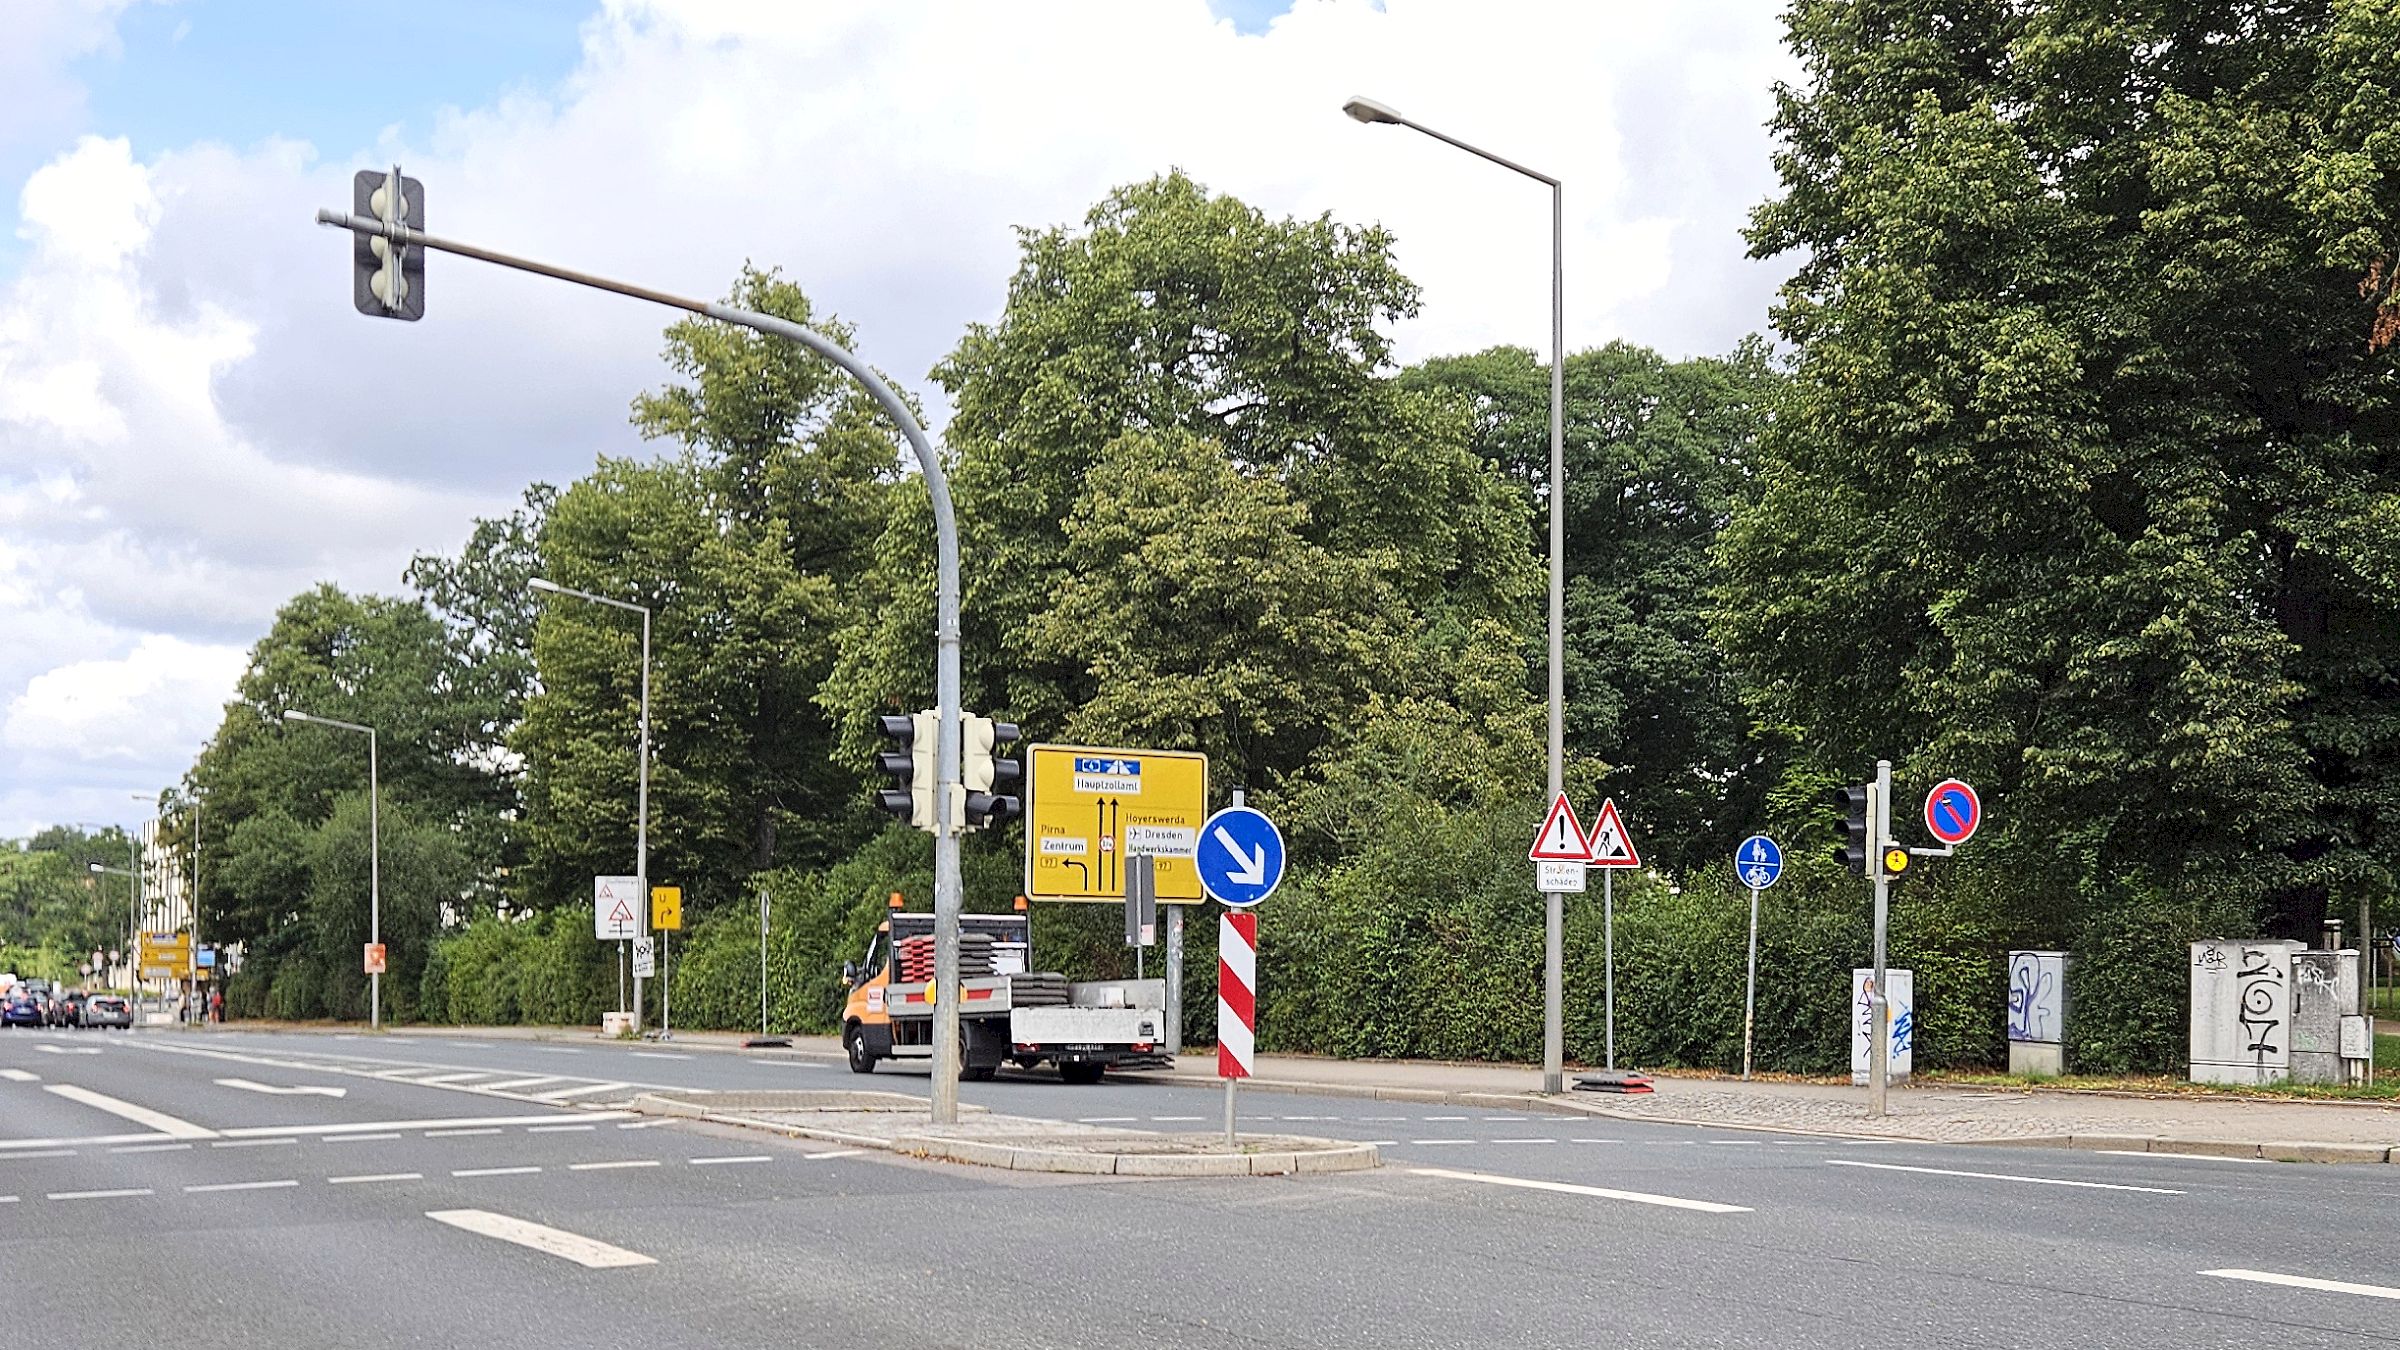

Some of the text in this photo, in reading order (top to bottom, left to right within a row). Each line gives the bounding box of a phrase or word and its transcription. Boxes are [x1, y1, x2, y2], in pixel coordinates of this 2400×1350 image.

[1077, 778, 1138, 791] Hauptzollamt
[1126, 812, 1185, 825] Hoyerswerda
[1041, 824, 1066, 835] Pirna
[1145, 829, 1183, 840] Dresden
[1044, 840, 1084, 851] Zentrum
[1128, 844, 1192, 855] Handwerkskammer
[659, 894, 666, 902] U
